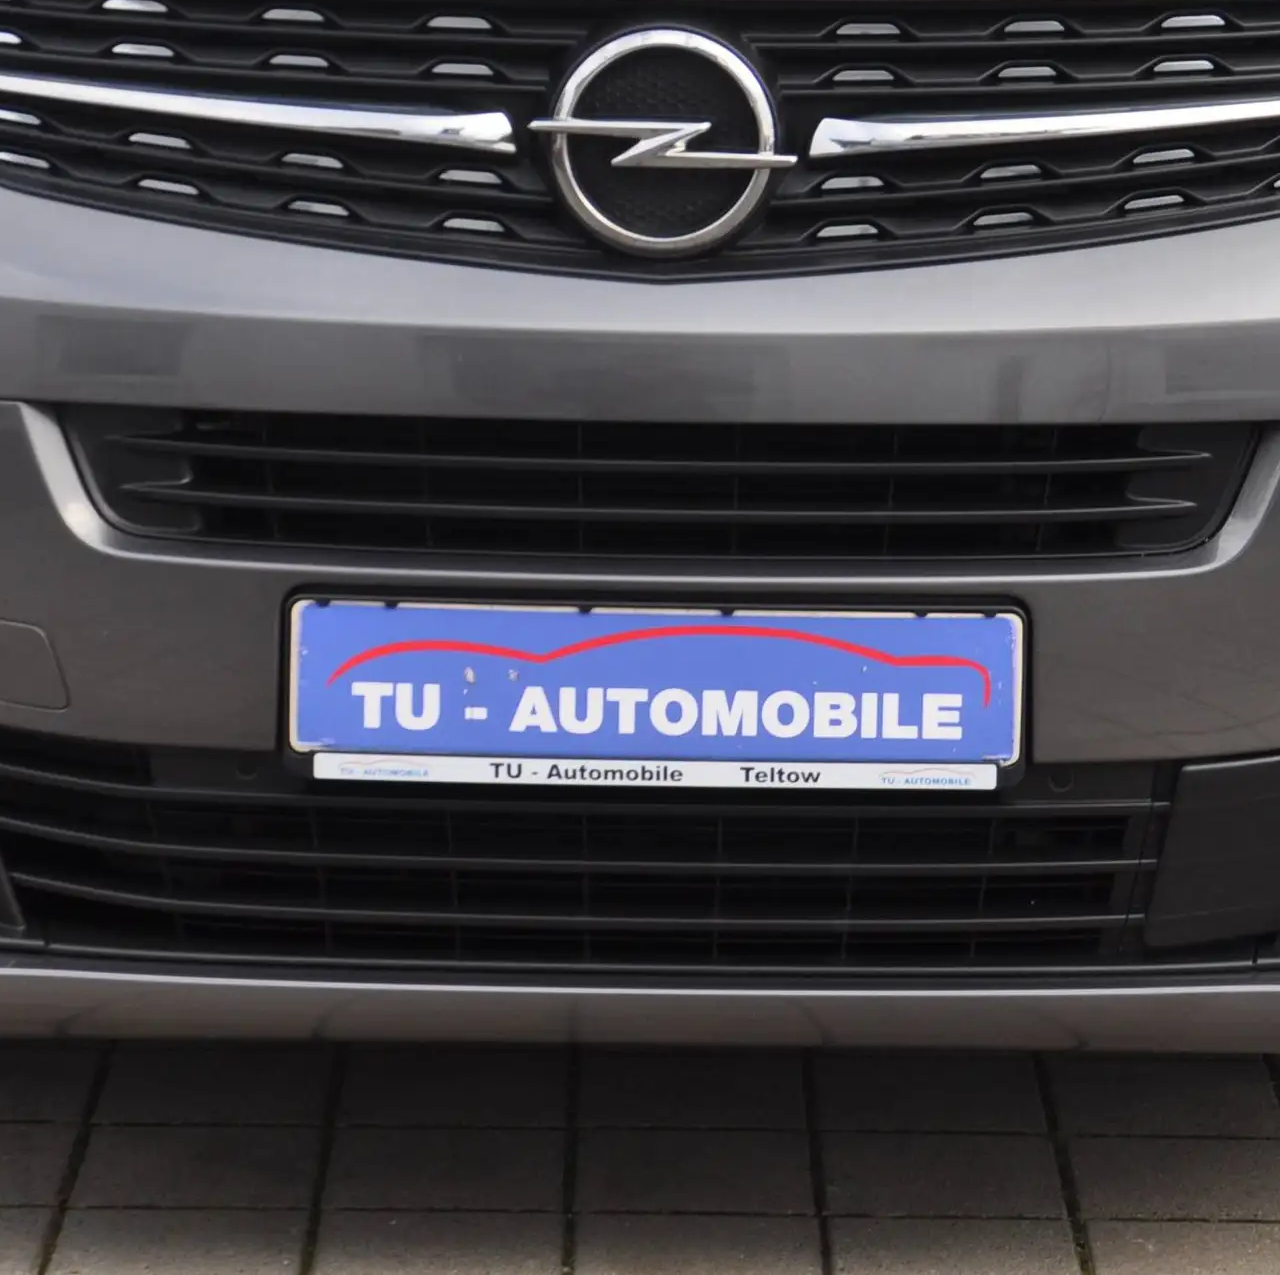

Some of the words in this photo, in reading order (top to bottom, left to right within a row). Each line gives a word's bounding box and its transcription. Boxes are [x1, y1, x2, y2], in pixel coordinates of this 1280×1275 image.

[351, 682, 441, 731] TU
[464, 706, 488, 720] -
[509, 686, 963, 740] AUTOMOBILE
[489, 762, 523, 779] TU
[547, 763, 683, 783] Automobile
[740, 766, 821, 784] Teltow
[880, 776, 895, 786] TU
[904, 776, 971, 786] AUTOMOBILE
